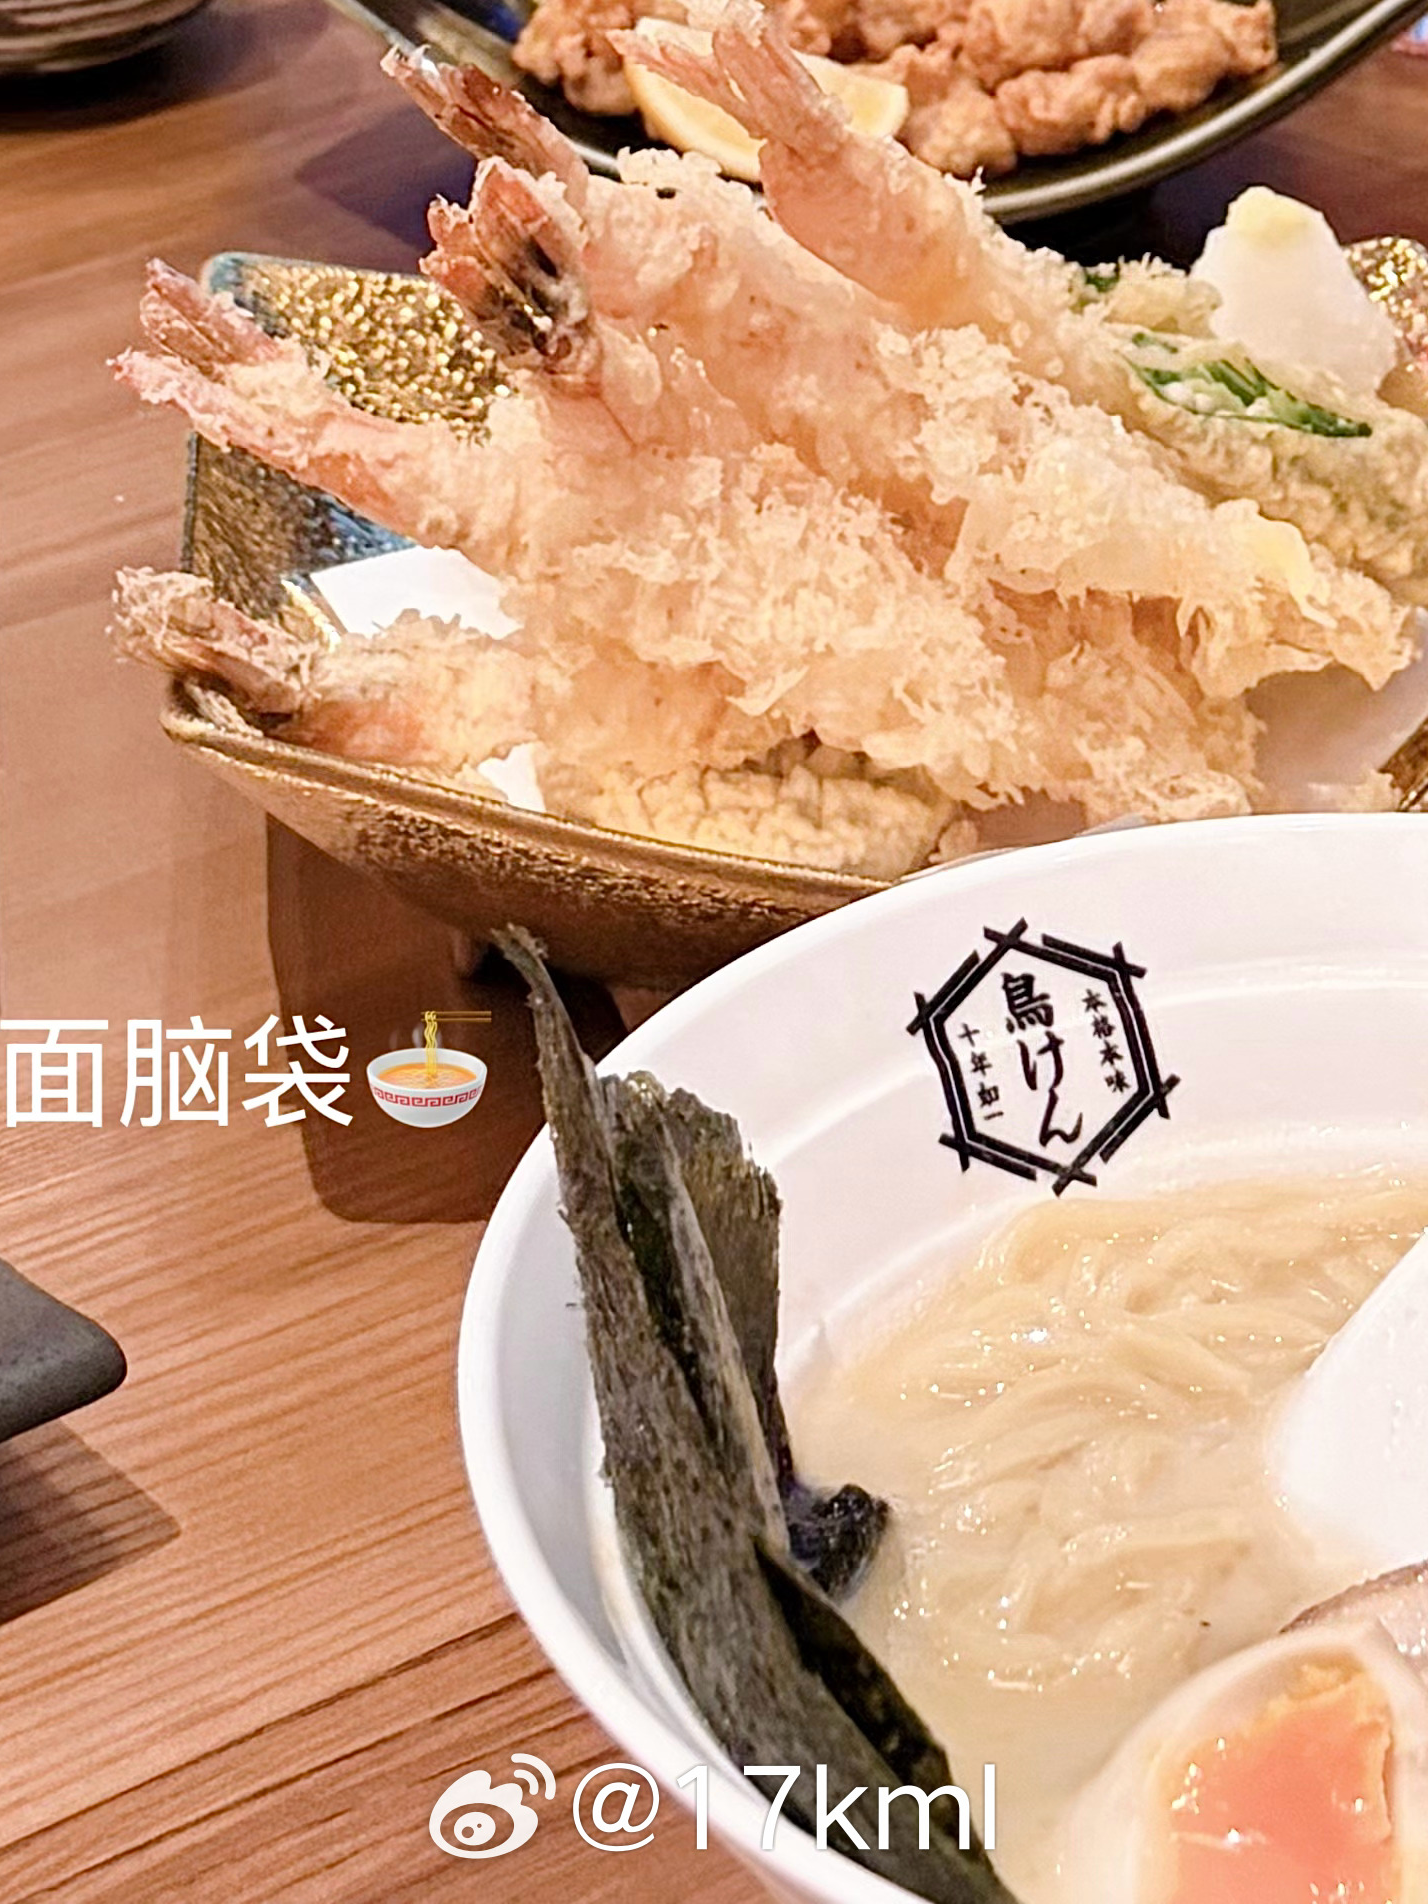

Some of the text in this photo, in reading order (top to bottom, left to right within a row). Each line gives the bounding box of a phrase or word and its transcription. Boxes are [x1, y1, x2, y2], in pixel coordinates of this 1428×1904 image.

[959, 1023, 1005, 1121] 十年如一
[1001, 972, 1083, 1147] 鳥けん
[1084, 989, 1131, 1094] 本格本味
